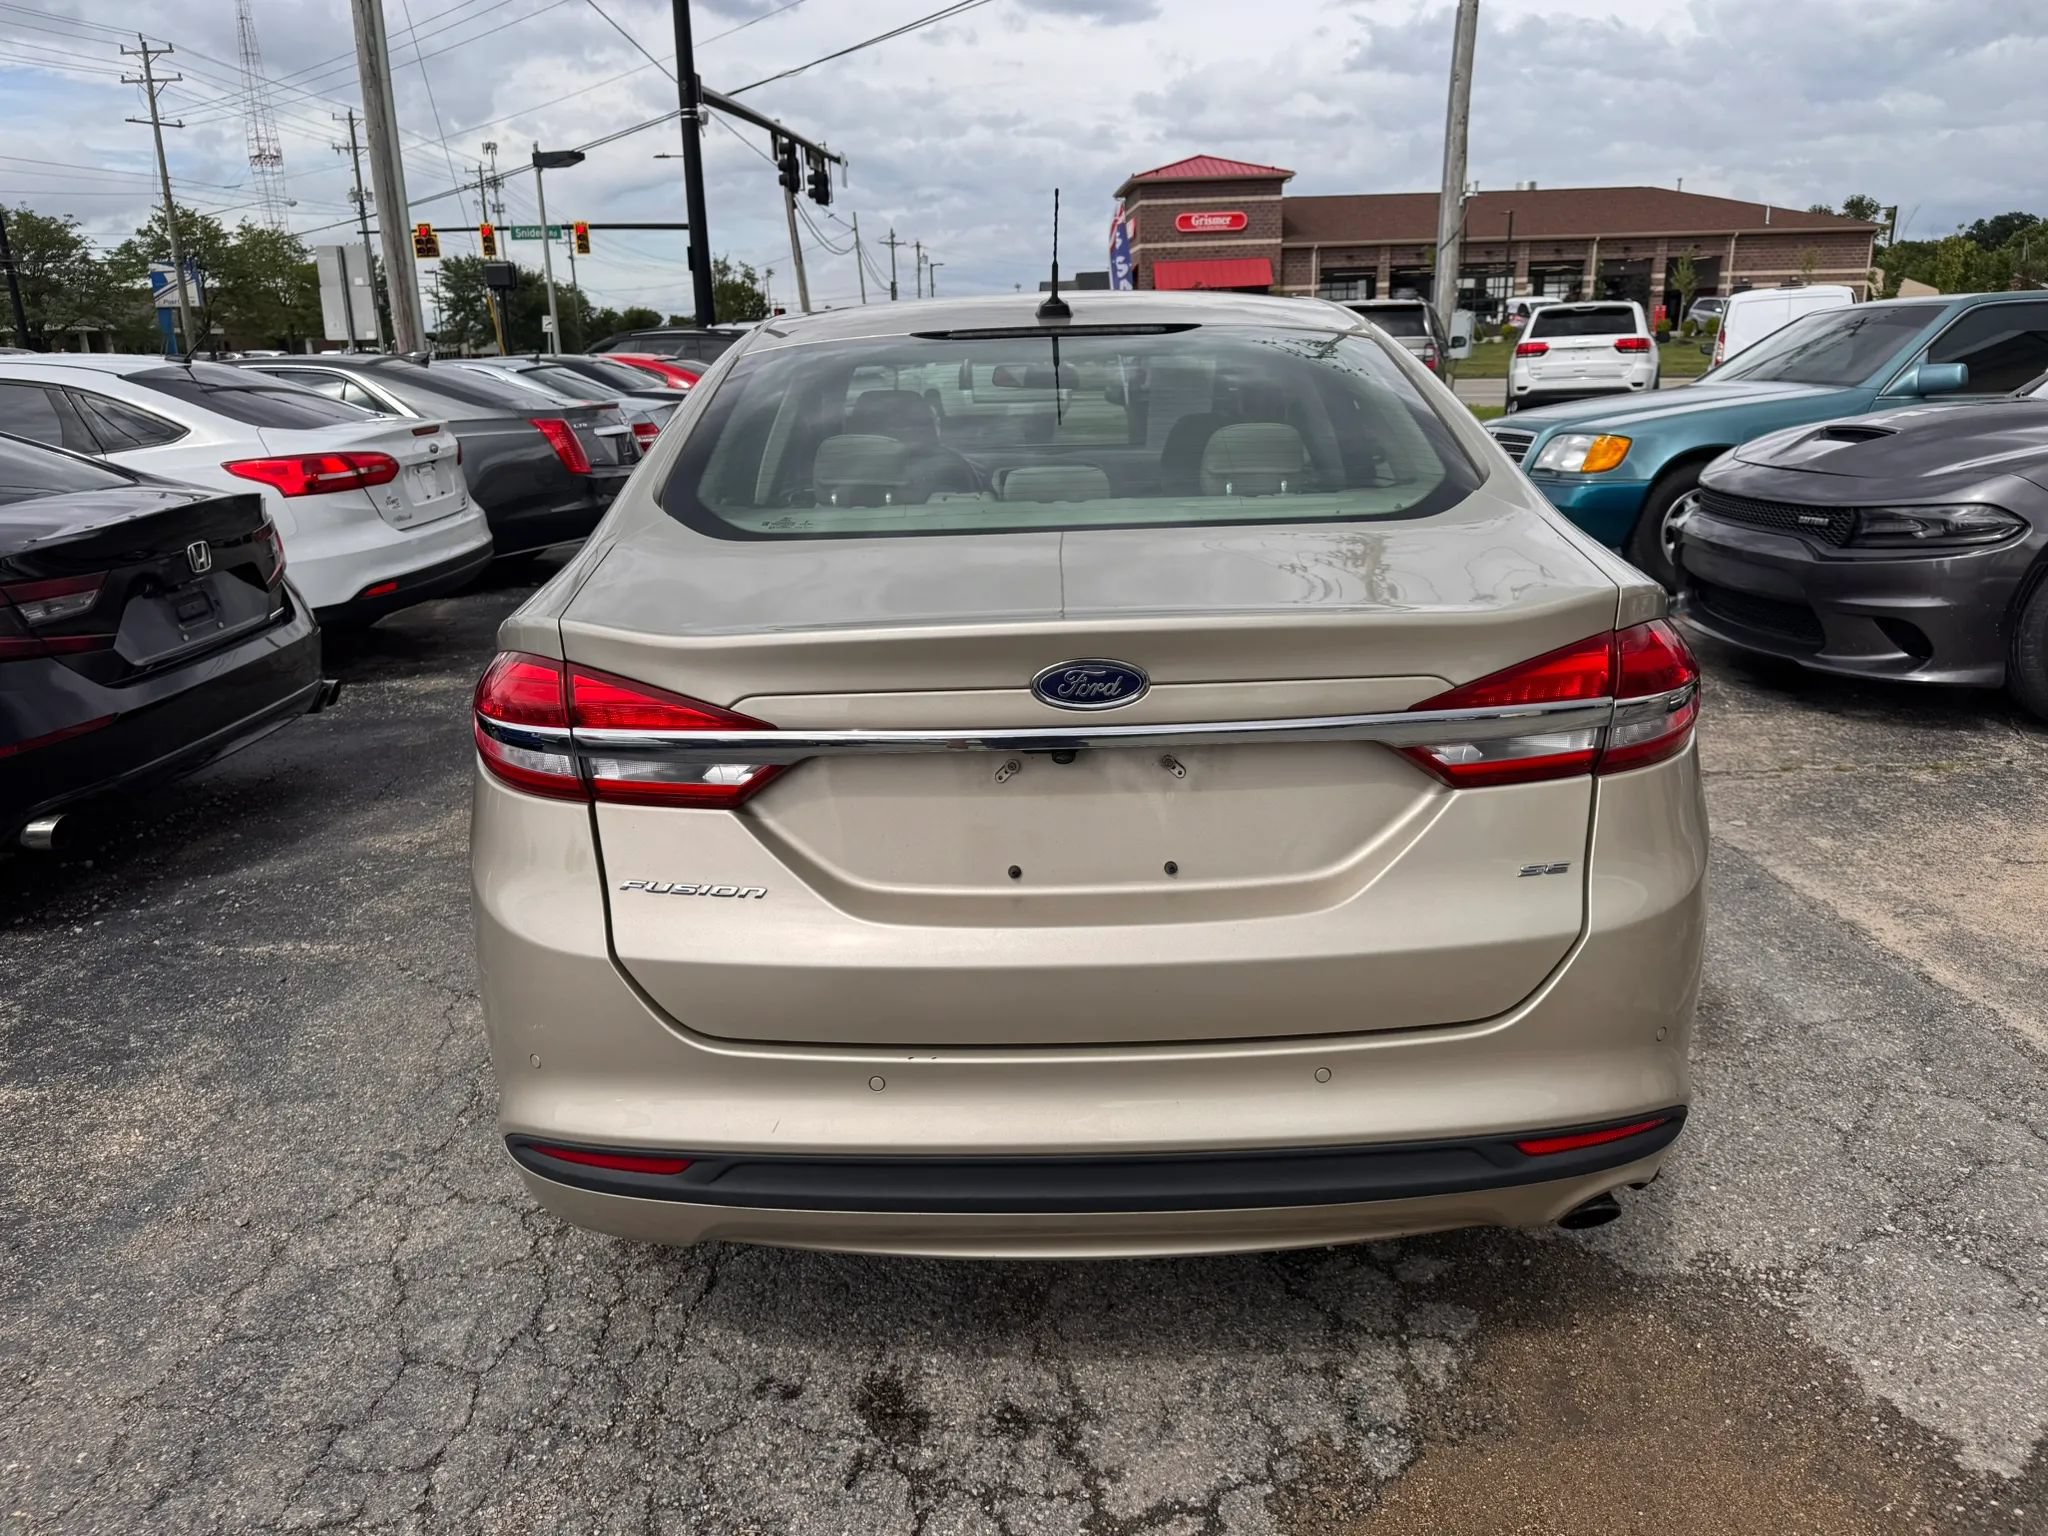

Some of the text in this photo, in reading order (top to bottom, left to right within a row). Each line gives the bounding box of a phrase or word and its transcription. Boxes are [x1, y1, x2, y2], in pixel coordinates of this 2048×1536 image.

[1190, 215, 1233, 226] Grismer
[515, 228, 542, 238] Snide
[1057, 669, 1124, 698] Ford
[1518, 862, 1571, 877] SE
[618, 878, 768, 899] FUSION
